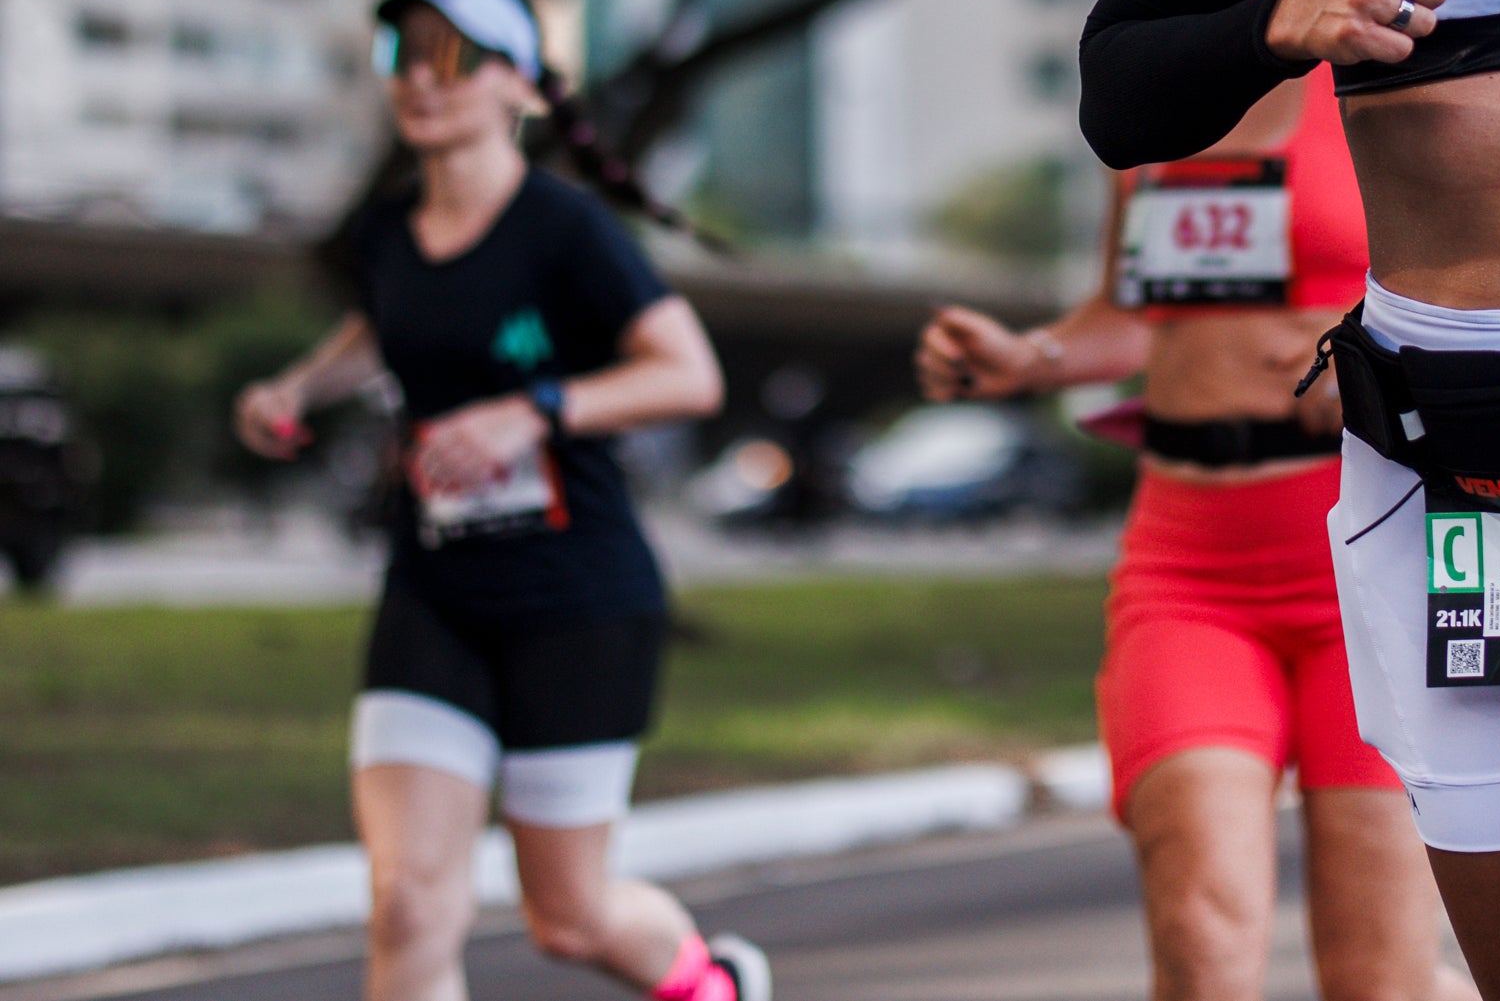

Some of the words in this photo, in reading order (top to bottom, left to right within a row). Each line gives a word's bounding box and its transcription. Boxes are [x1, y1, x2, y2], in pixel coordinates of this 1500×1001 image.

[1171, 202, 1253, 251] 632
[1443, 525, 1466, 582] C
[1436, 609, 1482, 628] 21.1K
